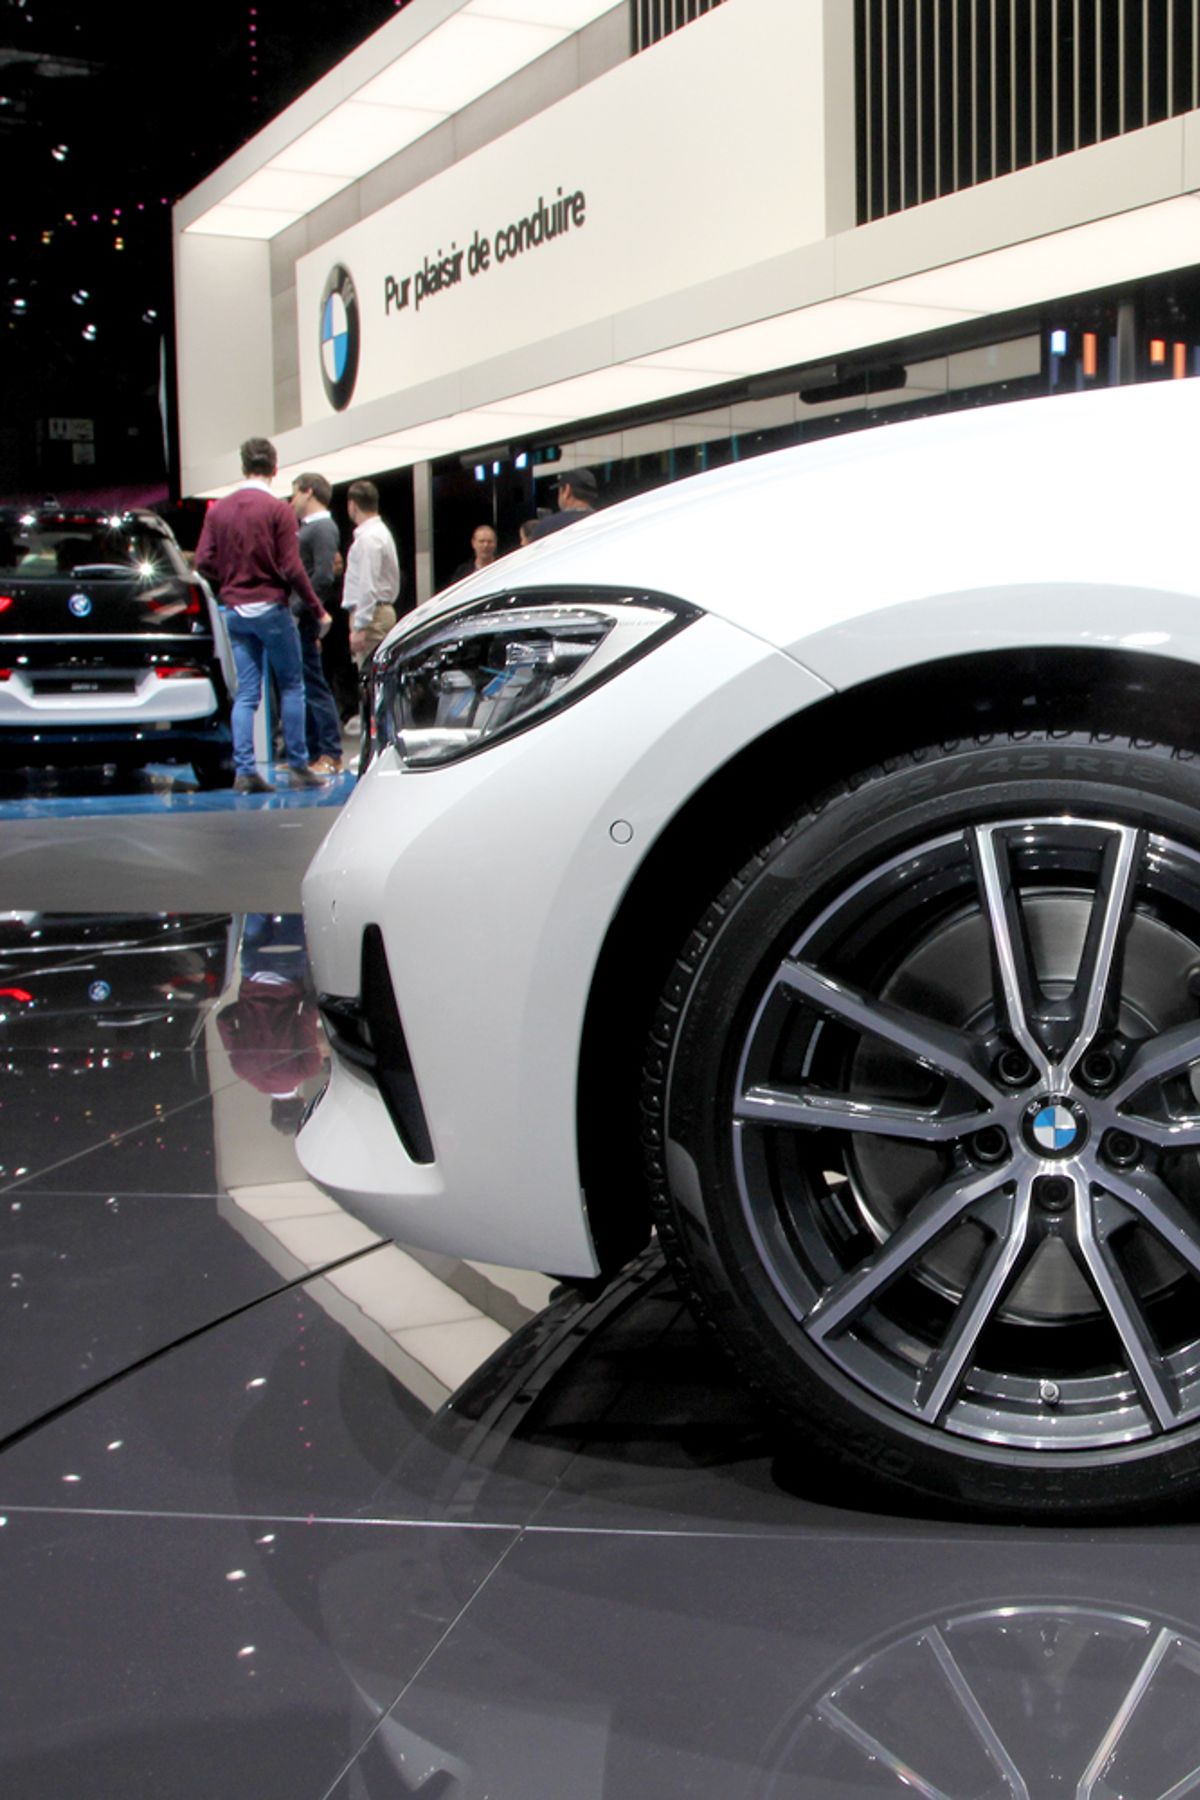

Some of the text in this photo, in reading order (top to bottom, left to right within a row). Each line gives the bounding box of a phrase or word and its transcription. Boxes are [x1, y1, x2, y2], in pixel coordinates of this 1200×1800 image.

[385, 275, 411, 315] Pur
[414, 242, 464, 311] plaisir
[468, 230, 491, 276] de
[494, 186, 586, 263] conduire
